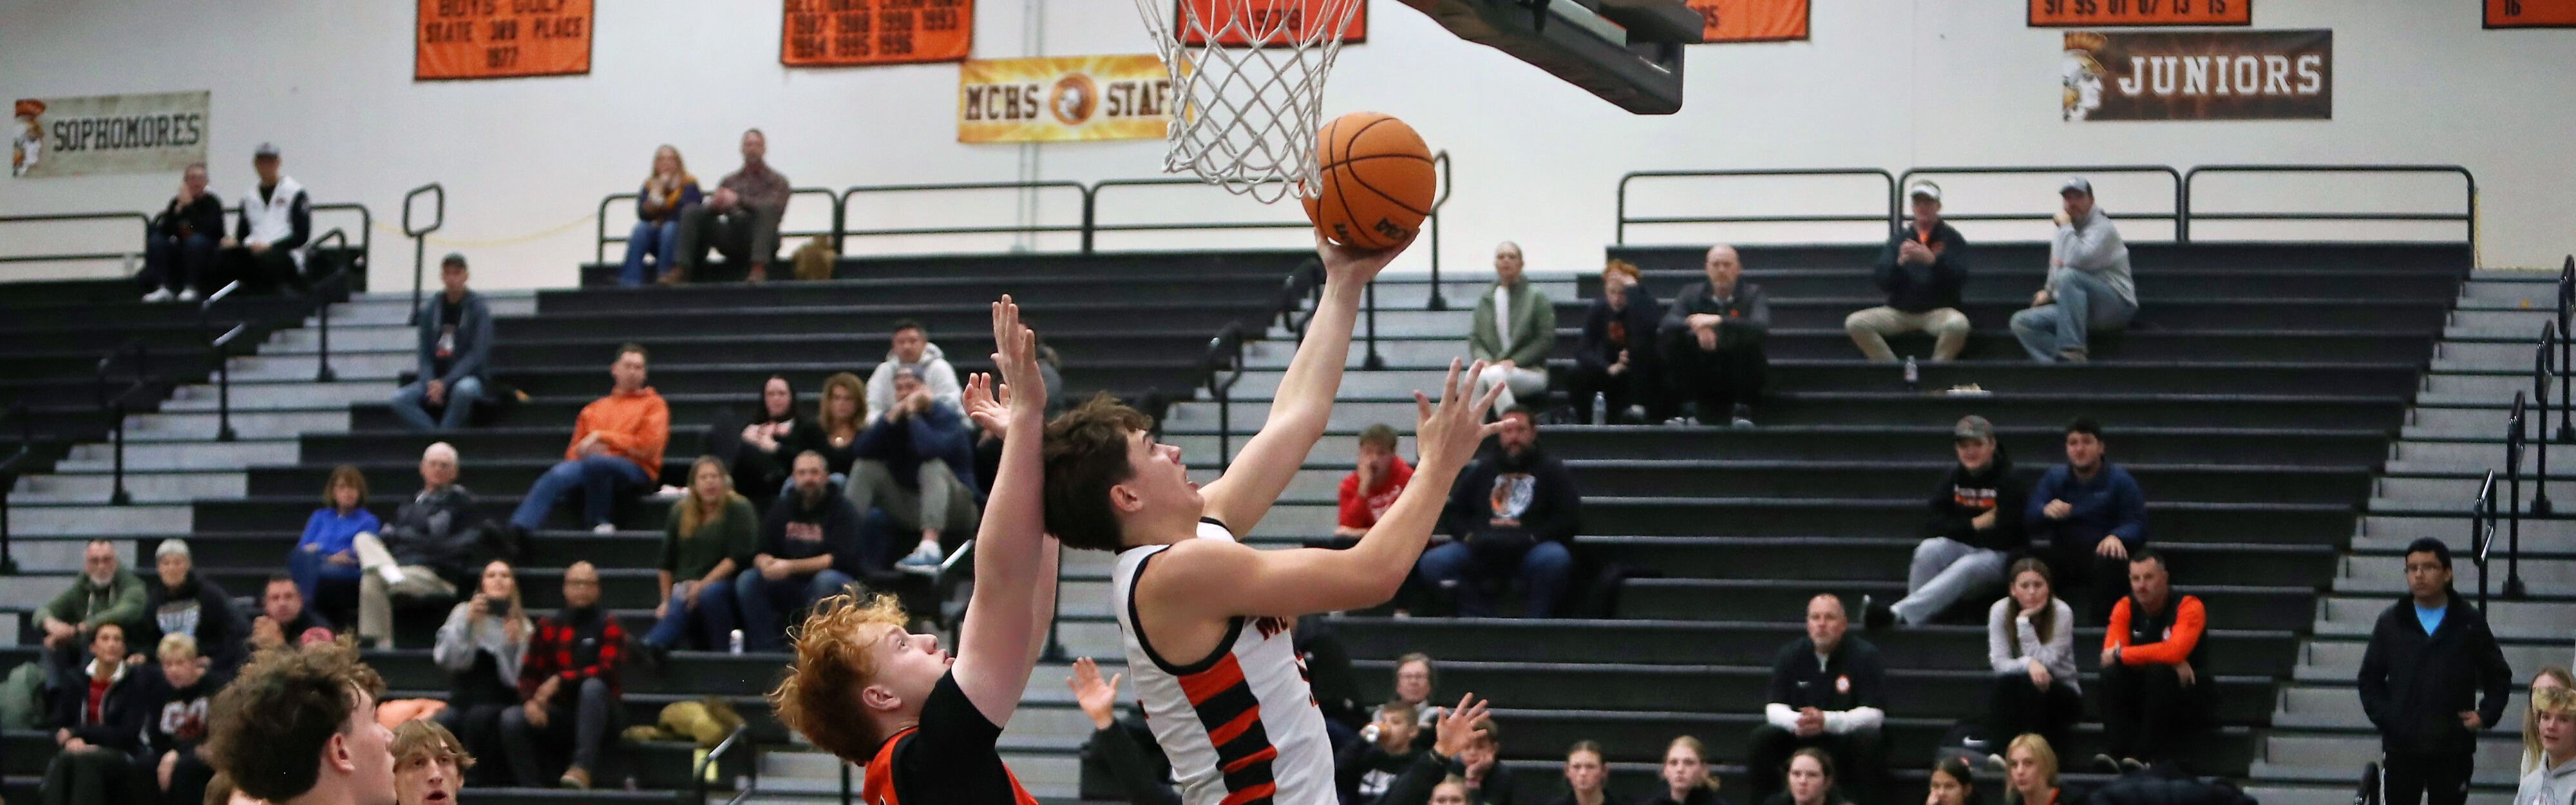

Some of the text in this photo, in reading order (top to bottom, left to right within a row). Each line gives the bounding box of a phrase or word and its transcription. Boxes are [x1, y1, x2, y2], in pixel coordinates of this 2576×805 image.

[439, 0, 496, 17] BOYS
[425, 21, 472, 43] STATE
[534, 17, 583, 39] PLACE
[488, 46, 518, 68] 1977
[2117, 55, 2322, 95] JUNIORS
[965, 80, 1179, 120] MCHS STAF
[53, 113, 200, 151] SOPHOMORES
